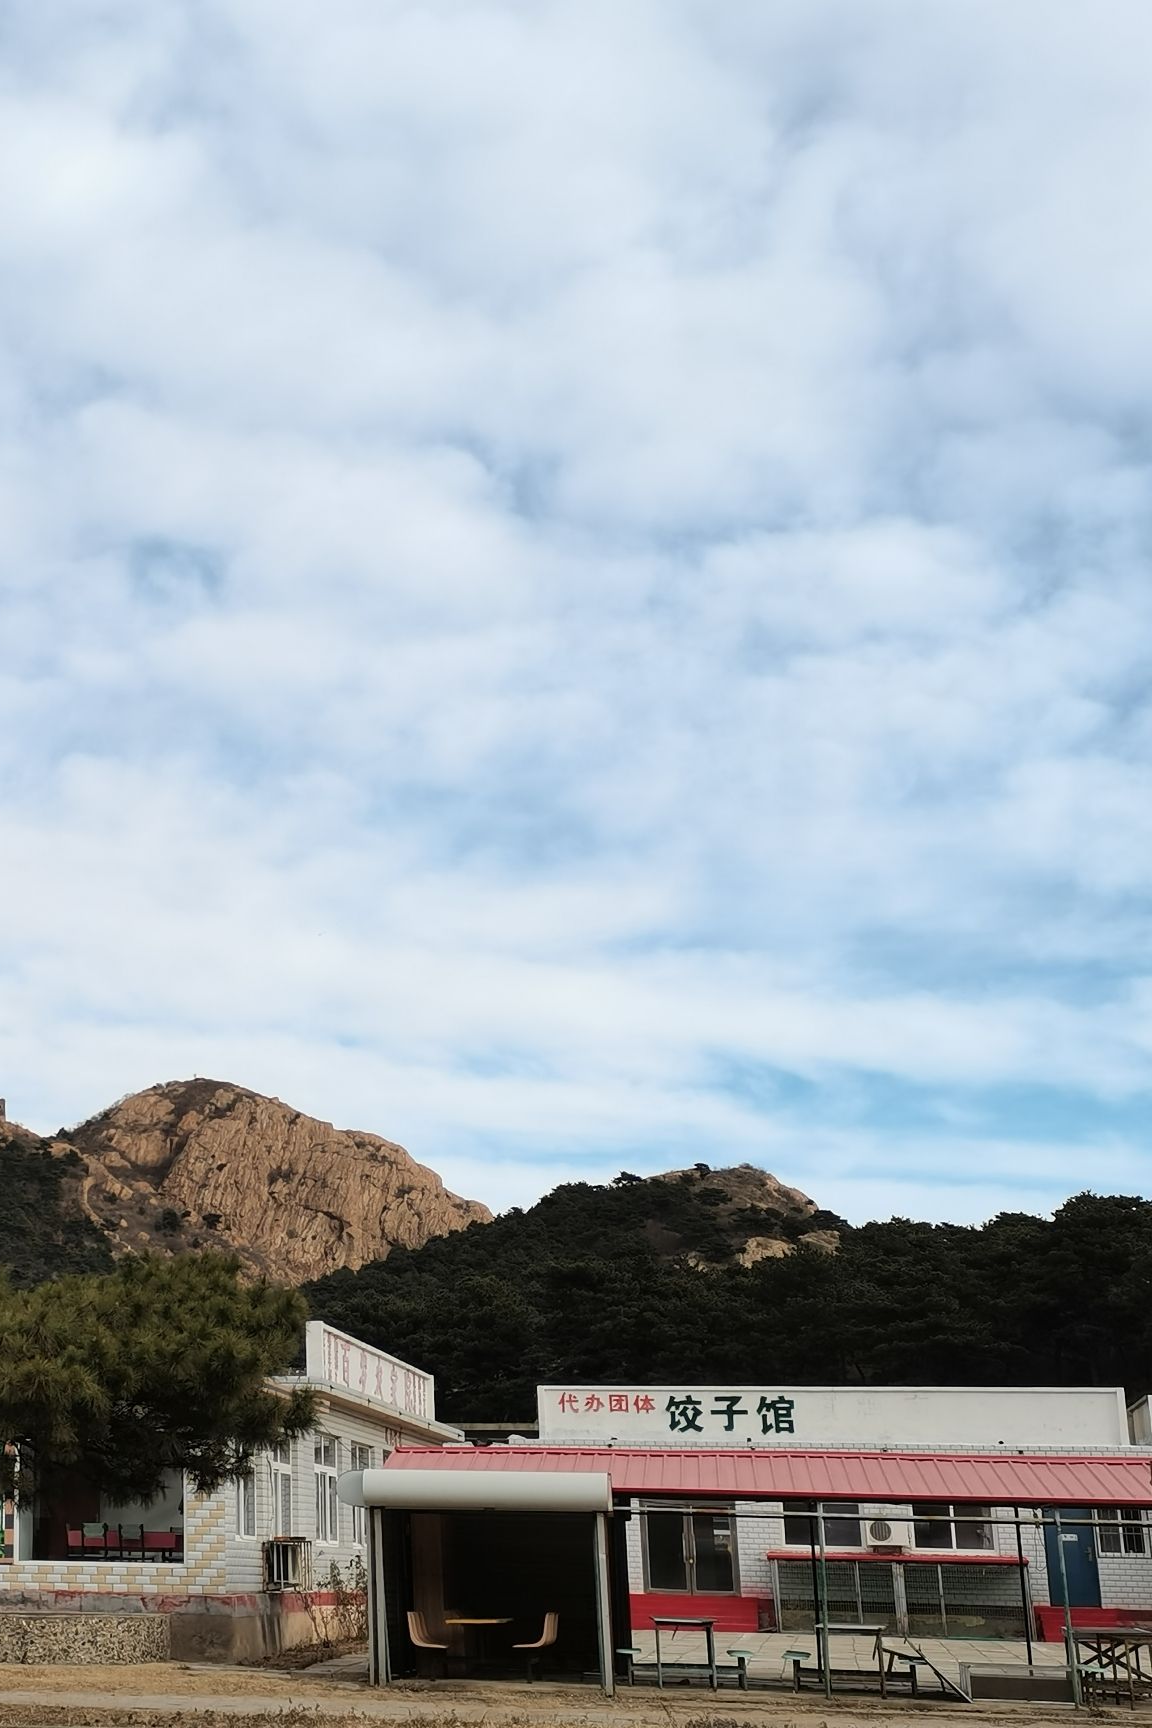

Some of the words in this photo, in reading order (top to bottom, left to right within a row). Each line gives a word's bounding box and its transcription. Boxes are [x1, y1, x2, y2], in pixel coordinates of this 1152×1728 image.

[559, 1392, 656, 1414] 代办团体
[666, 1395, 795, 1435] 饺子馆
